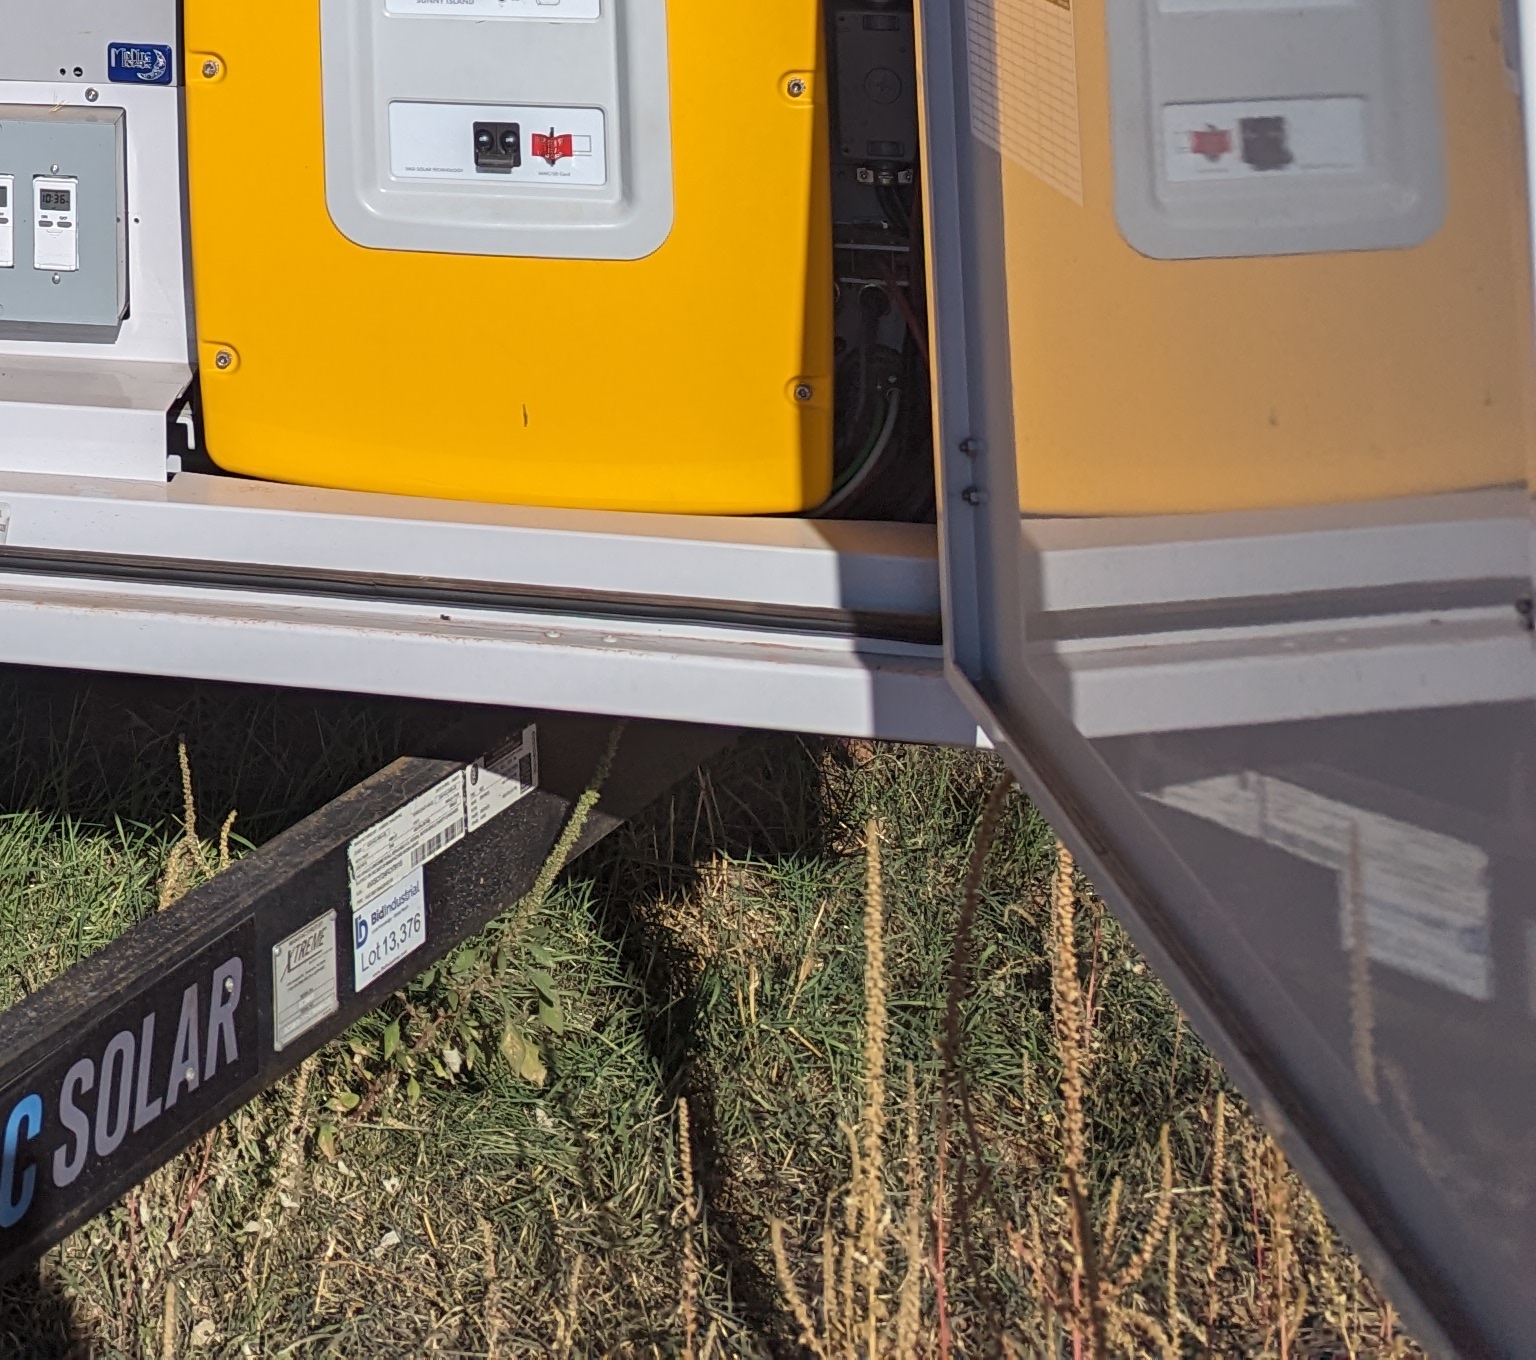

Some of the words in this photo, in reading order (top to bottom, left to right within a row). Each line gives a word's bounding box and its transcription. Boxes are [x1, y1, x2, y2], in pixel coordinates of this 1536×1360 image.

[360, 941, 382, 973] Lot
[382, 912, 422, 956] 13,376
[52, 956, 243, 1188] SOLAR
